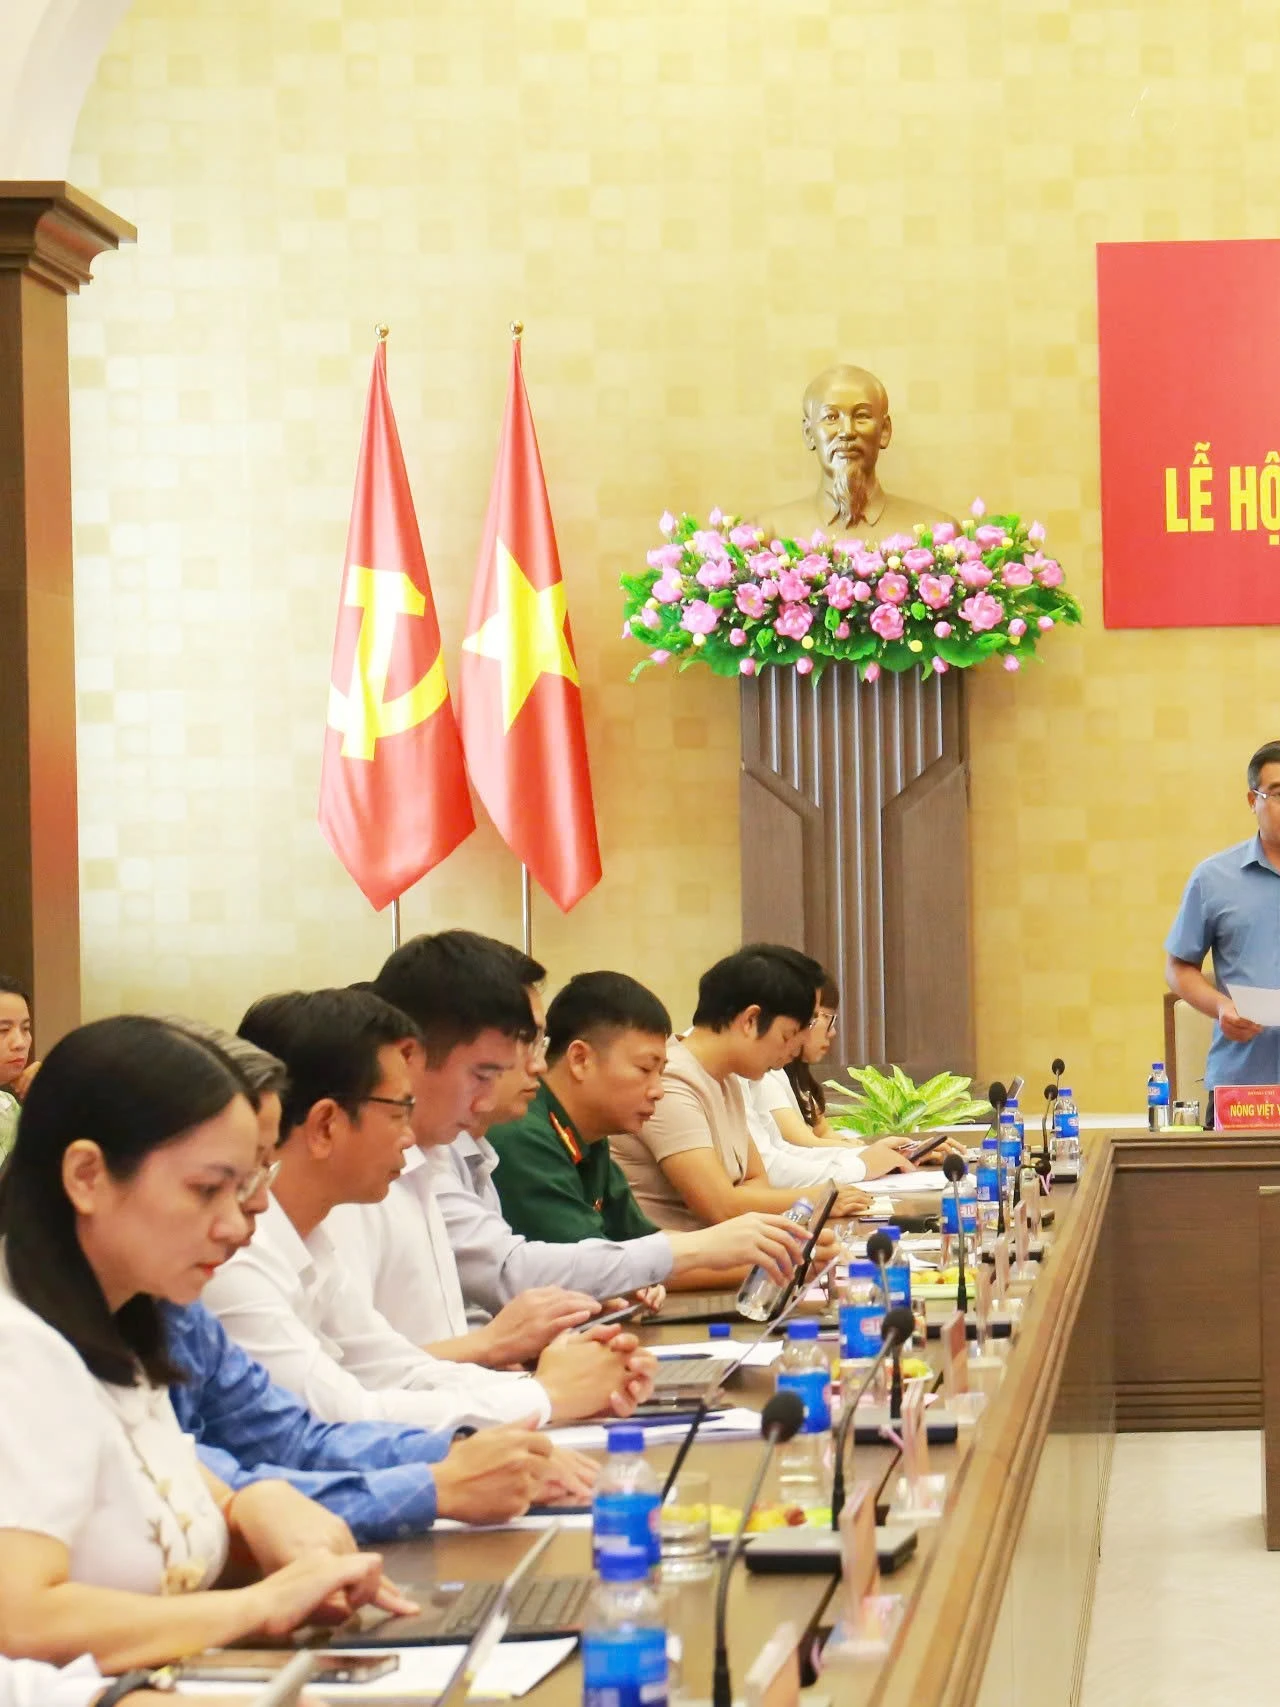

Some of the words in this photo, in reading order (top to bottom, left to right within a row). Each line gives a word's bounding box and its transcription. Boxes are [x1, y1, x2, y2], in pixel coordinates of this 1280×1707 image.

[1165, 441, 1215, 533] LỄ
[1230, 1101, 1255, 1117] NÔNG
[1257, 1100, 1275, 1120] VIỆT
